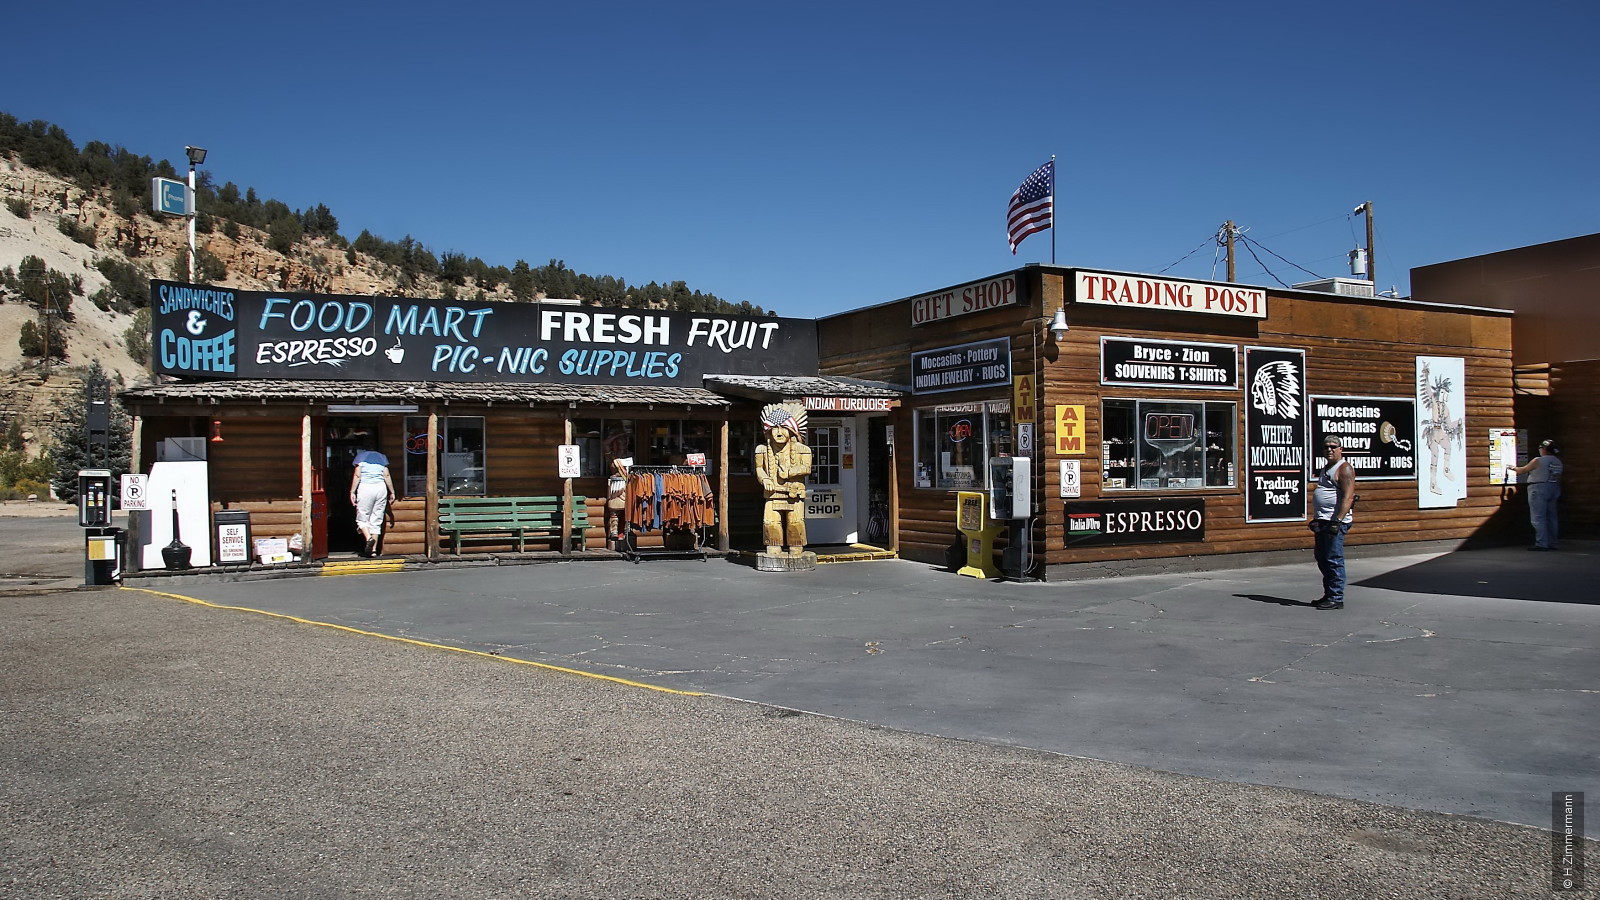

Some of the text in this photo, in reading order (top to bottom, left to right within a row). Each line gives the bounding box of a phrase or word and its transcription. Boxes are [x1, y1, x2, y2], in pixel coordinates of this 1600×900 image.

[159, 284, 235, 322] SANDWICHES
[912, 278, 1015, 323] GIFT SHOP
[1083, 275, 1262, 314] TRADING POST
[185, 310, 207, 335] &
[258, 298, 493, 343] FOOD MART
[540, 310, 779, 353] FRESH FRUIT
[160, 328, 235, 373] COFFEE
[256, 337, 377, 365] ESPRESSO
[921, 347, 998, 370] Moccasins Pottery
[1134, 345, 1210, 362] Bryce Zion
[431, 344, 682, 379] PIC-NIC SUPPLIES
[916, 364, 1005, 388] INDIAN JEWELRY RUGS
[1115, 364, 1175, 381] SOUVENIRS
[805, 397, 890, 410] INDIAN TURQUOISE
[1018, 376, 1033, 420] ATM
[1317, 404, 1381, 418] Moccasins
[950, 425, 971, 437] OPEN
[1060, 408, 1080, 450] ATM
[1147, 416, 1193, 438] OPEN
[1260, 425, 1292, 444] WHITE
[1322, 420, 1377, 434] Kachinas
[1340, 436, 1371, 449] ottery
[1251, 447, 1302, 466] MOUNTAIN
[1390, 456, 1412, 468] RUGS
[1066, 462, 1074, 470] NO
[129, 476, 140, 484] NO
[1255, 476, 1299, 493] Trading
[812, 494, 836, 502] GIFT
[1062, 486, 1078, 494] PARKING
[1264, 491, 1290, 505] Post
[124, 500, 146, 508] PARKING
[808, 505, 840, 514] SHOP
[1106, 509, 1202, 534] ESPRESSO
[222, 536, 244, 544] SERVICE
